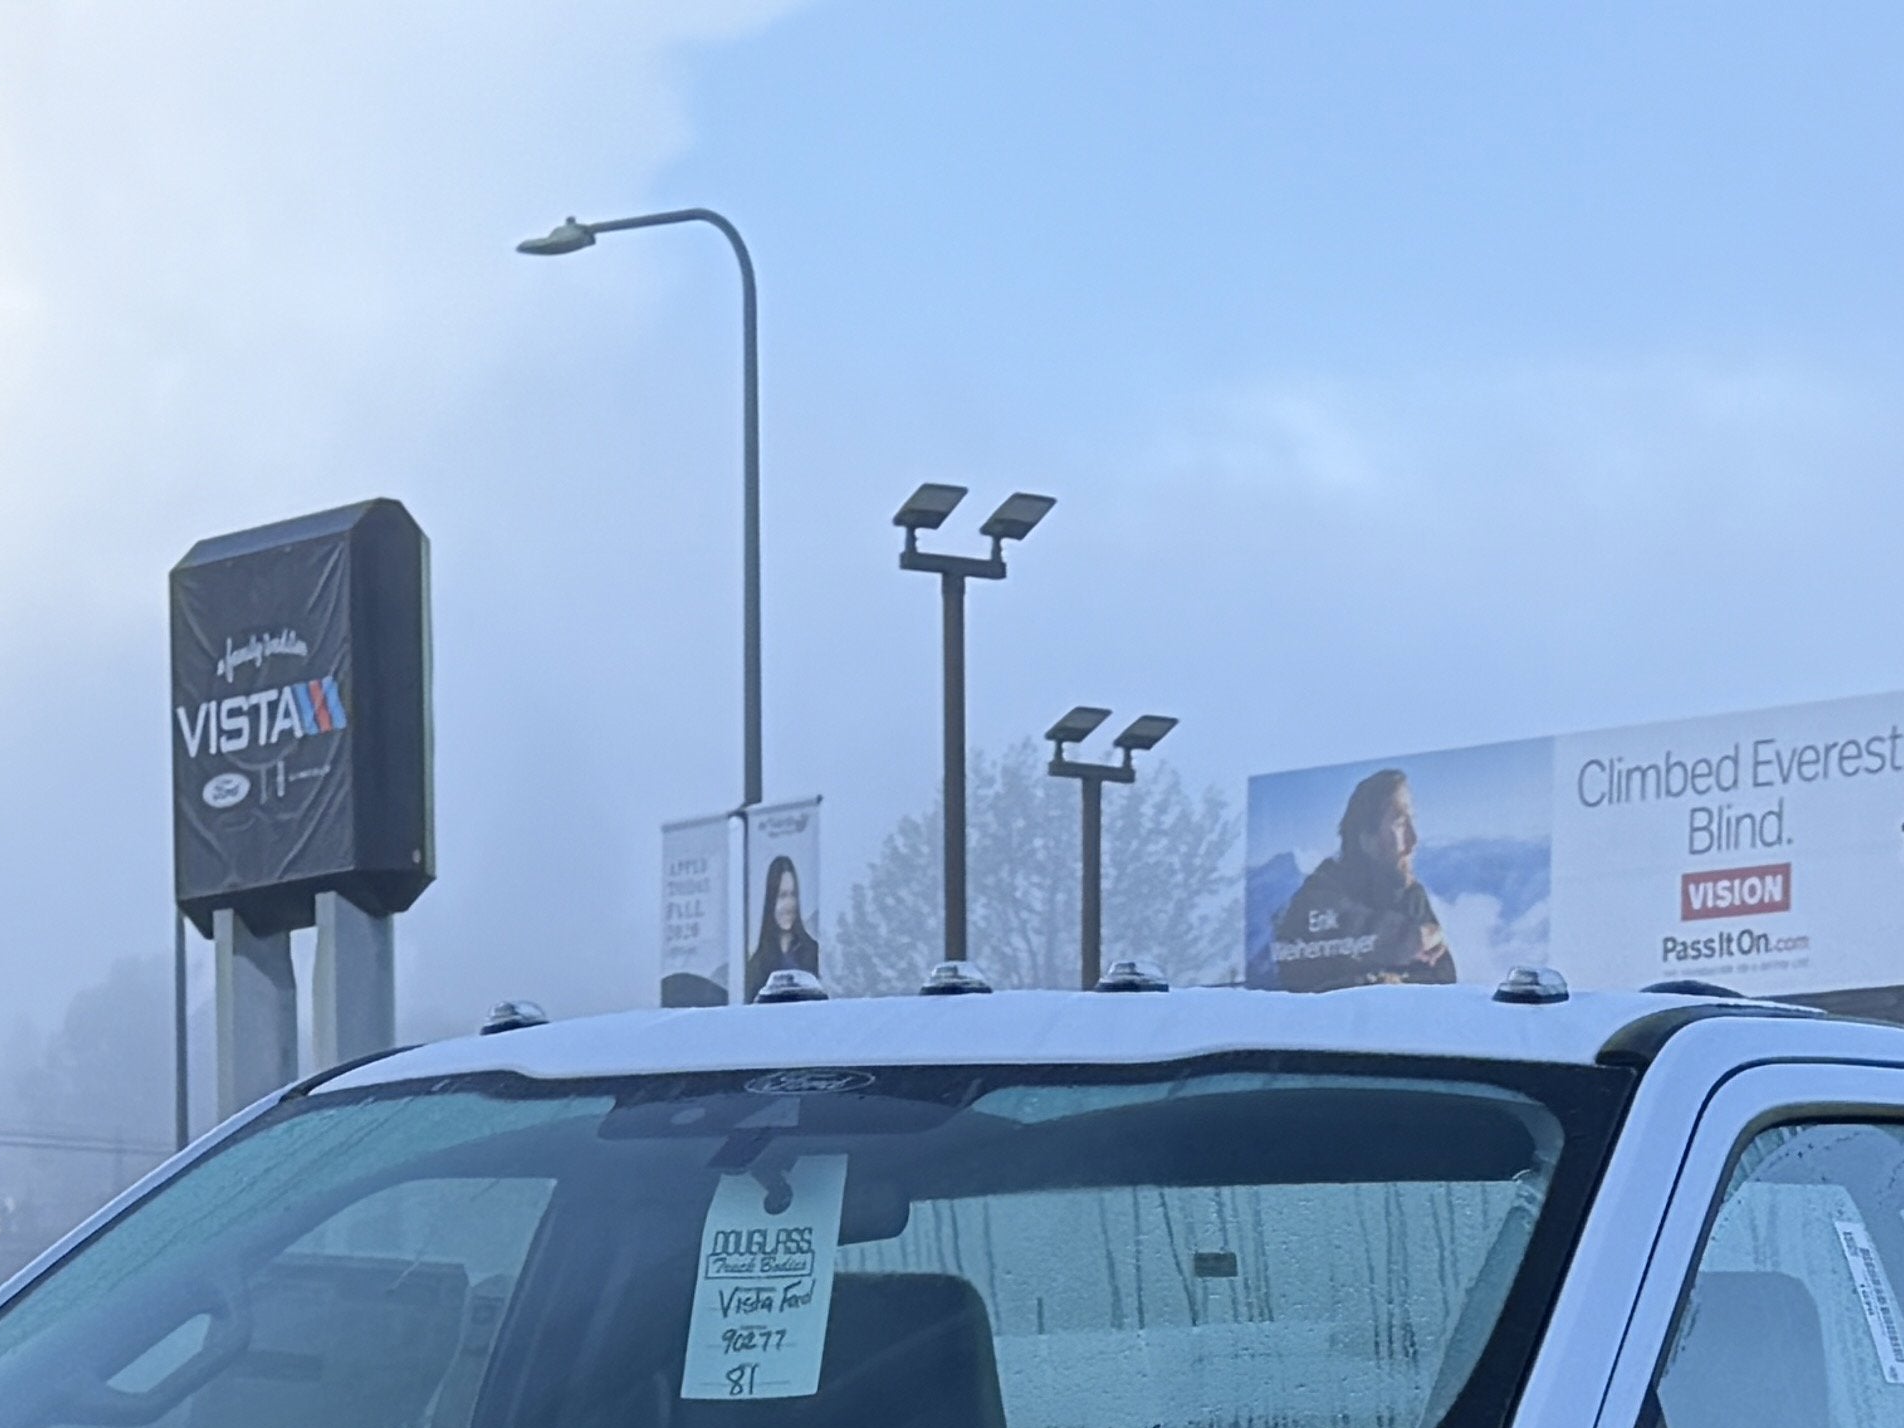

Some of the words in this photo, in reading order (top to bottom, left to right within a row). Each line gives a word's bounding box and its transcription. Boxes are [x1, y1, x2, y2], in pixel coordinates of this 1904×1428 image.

[176, 685, 304, 758] VISTA
[1577, 743, 1739, 808] Climbed
[1688, 797, 1794, 855] Blind.
[1687, 874, 1784, 911] VISION
[712, 1226, 813, 1256] DOUGLASS
[719, 1286, 774, 1319] Vista
[721, 1328, 787, 1355] 90277
[725, 1362, 760, 1396] 81
